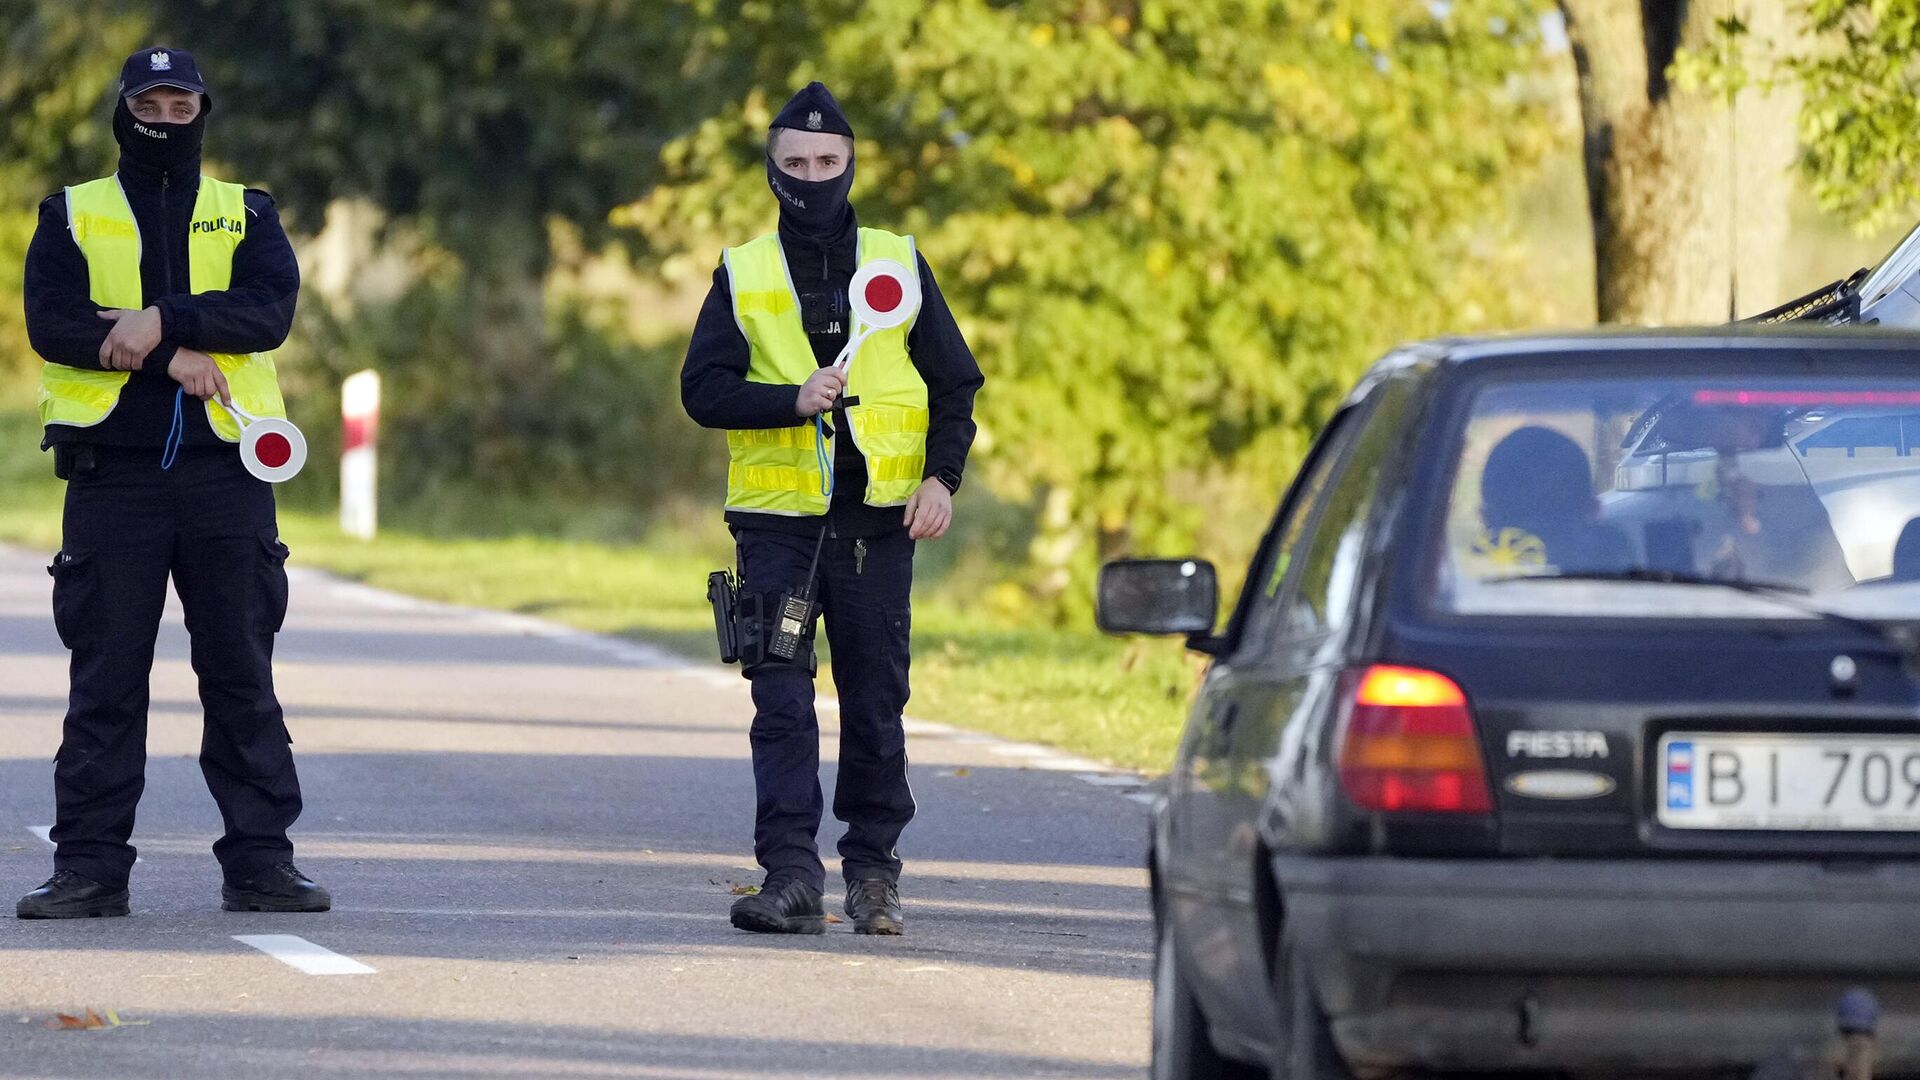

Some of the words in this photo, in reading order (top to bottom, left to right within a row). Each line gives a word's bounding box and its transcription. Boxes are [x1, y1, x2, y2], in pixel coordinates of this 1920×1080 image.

[133, 122, 168, 139] POLICJA
[192, 216, 242, 234] POLICJA
[1506, 730, 1609, 759] FIESTA
